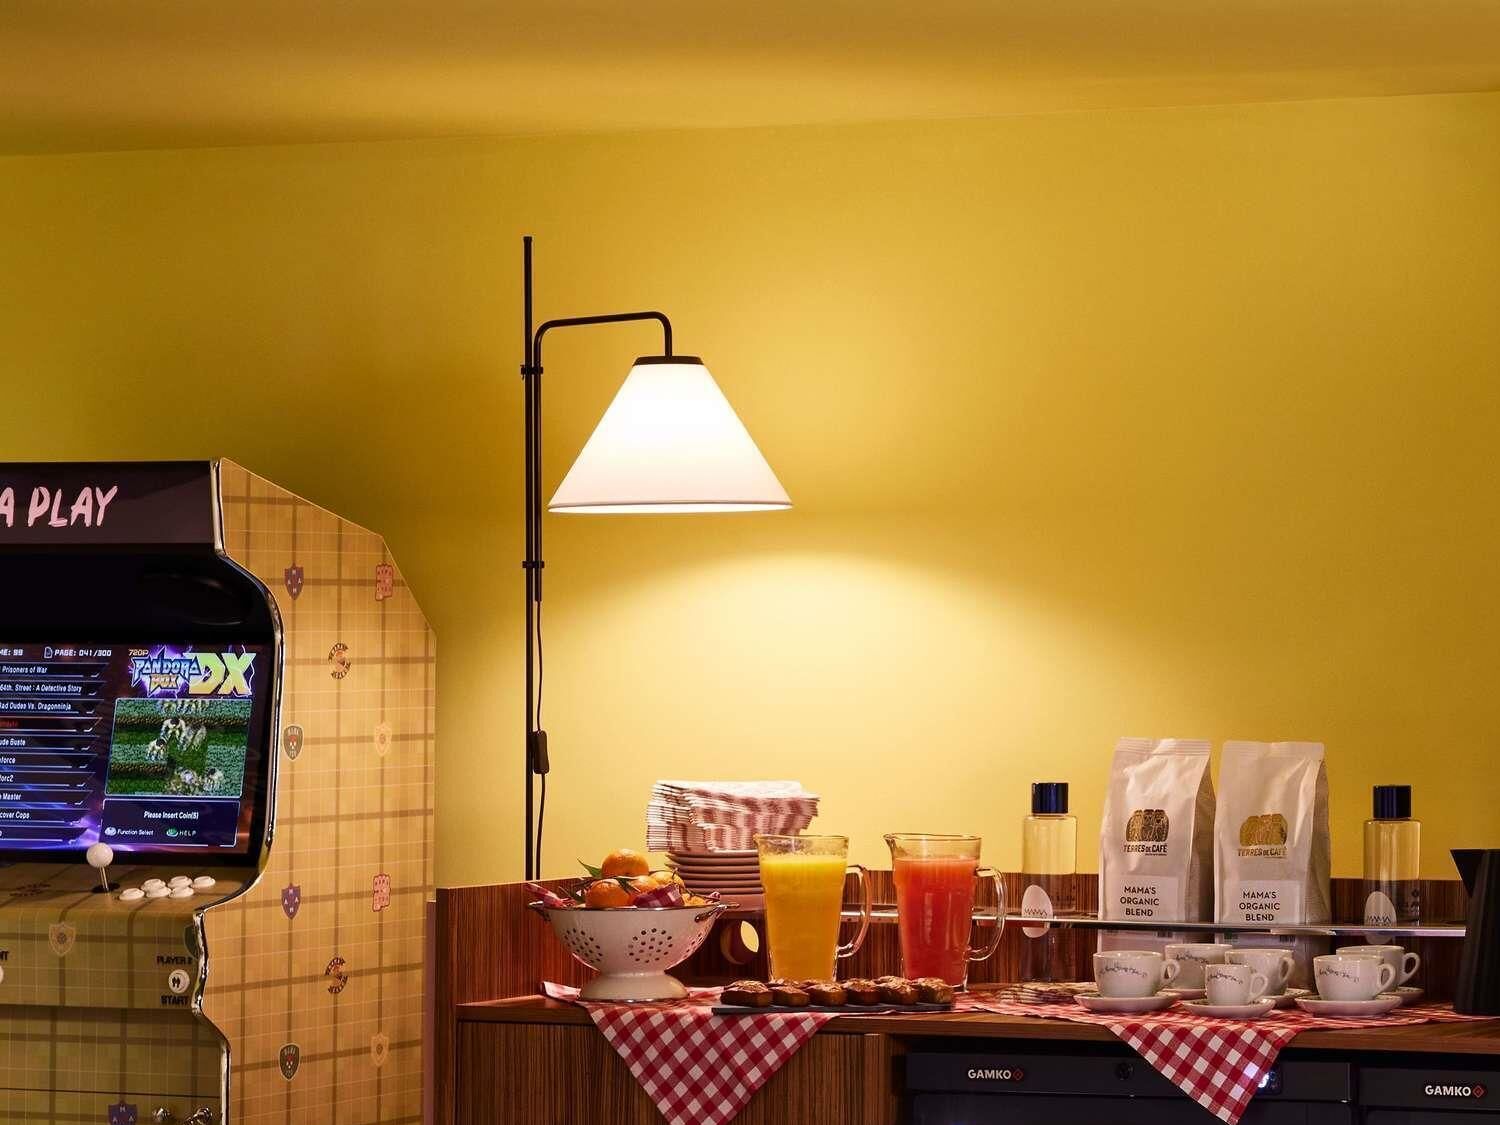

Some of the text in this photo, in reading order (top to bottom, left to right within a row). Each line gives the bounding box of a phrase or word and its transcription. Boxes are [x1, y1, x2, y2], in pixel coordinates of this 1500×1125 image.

[28, 485, 118, 528] PLAY
[2, 666, 29, 674] Prisoners
[131, 656, 202, 683] PANDORA
[184, 652, 256, 695] DX
[15, 684, 31, 692] Street
[41, 684, 67, 692] Detective
[67, 685, 82, 693] Story
[143, 811, 162, 819] Please
[163, 811, 178, 819] Insert
[1123, 844, 1145, 853] TERRES
[1238, 848, 1263, 857] TERRES
[1124, 886, 1156, 895] MAMA'S
[1243, 891, 1277, 899] MAMA'S
[1120, 897, 1160, 906] ORGANIC
[1239, 902, 1281, 911] ORGANIC
[1125, 908, 1154, 917] BLEND
[1245, 913, 1275, 921] BLEND
[968, 1069, 1012, 1079] GAMKO
[1425, 1085, 1472, 1097] GAMKO
